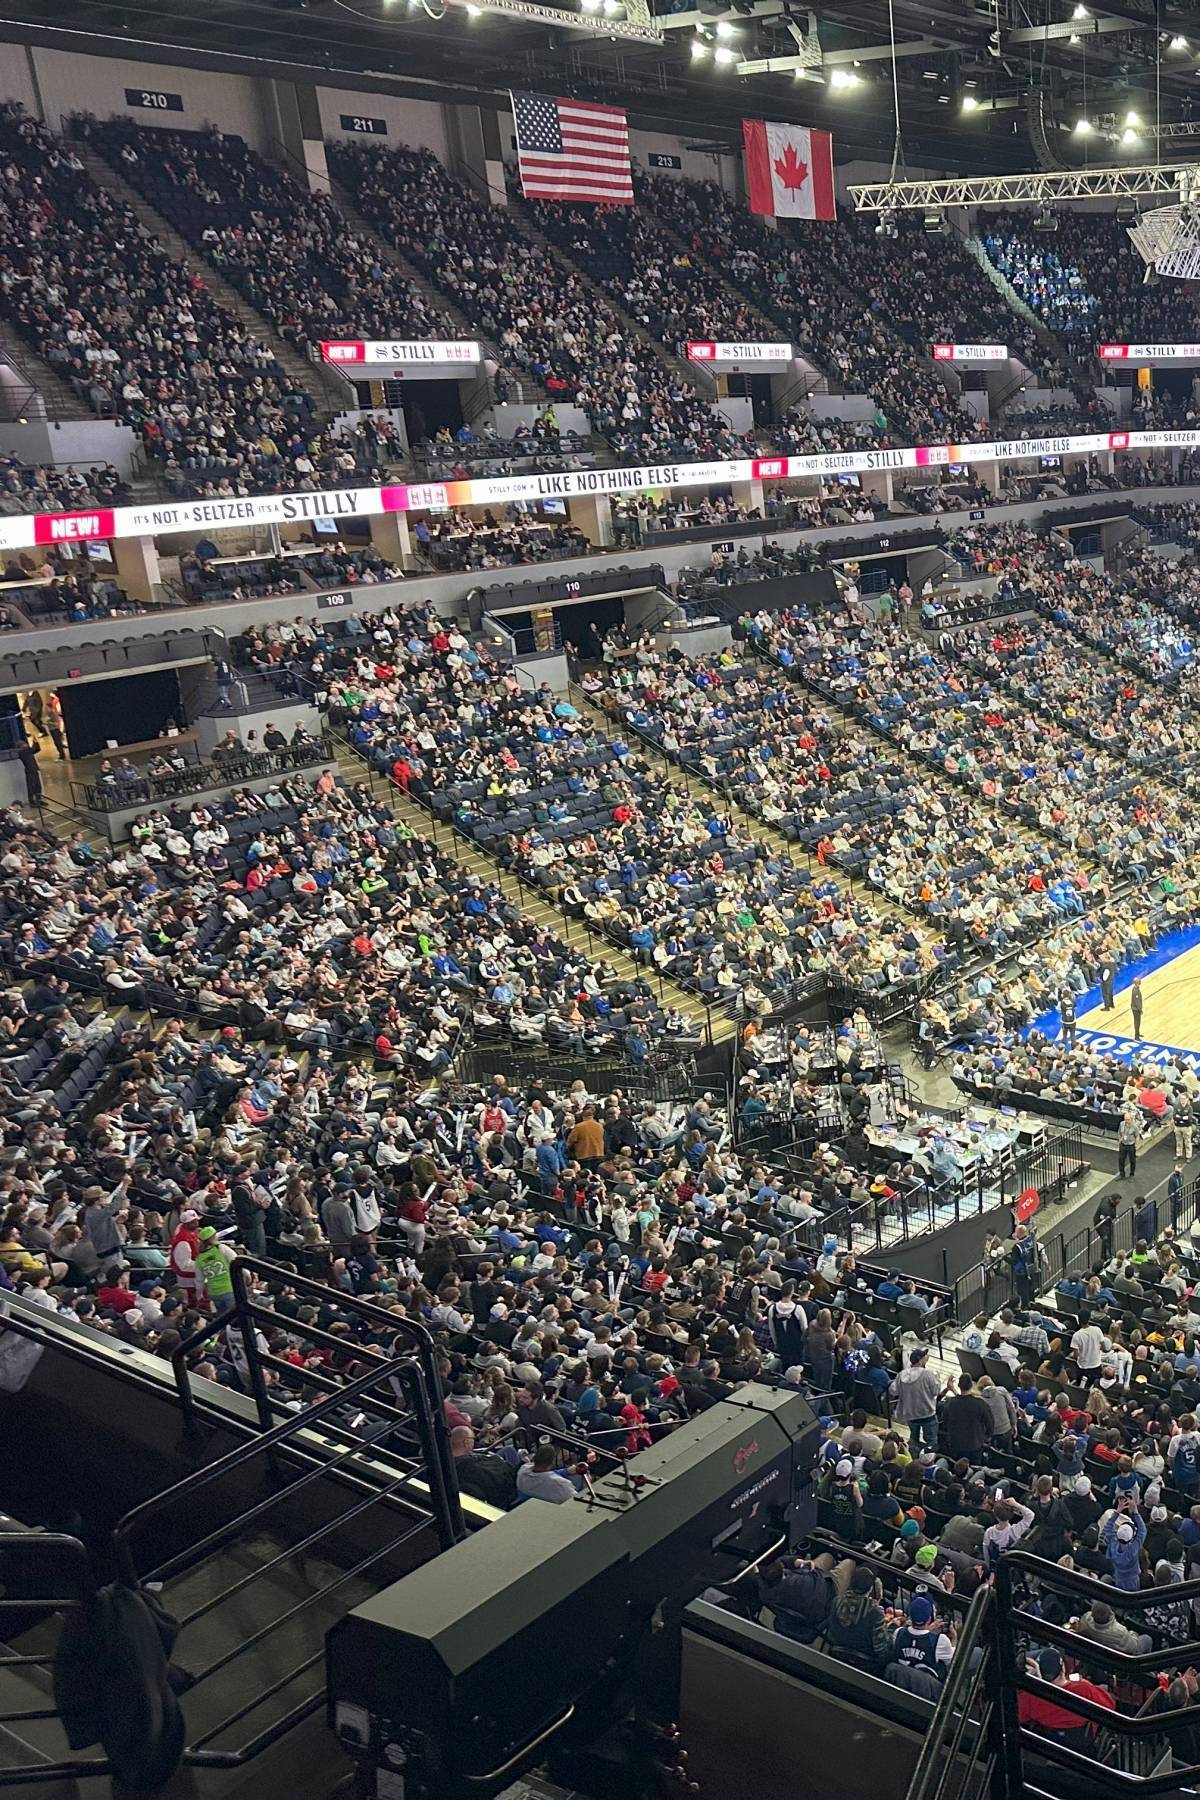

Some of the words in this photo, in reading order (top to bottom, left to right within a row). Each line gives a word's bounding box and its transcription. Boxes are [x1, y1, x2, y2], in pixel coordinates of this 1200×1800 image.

[142, 93, 168, 108] 210
[354, 118, 374, 132] 211
[658, 156, 673, 167] 213
[392, 345, 436, 359] STILLY
[734, 346, 762, 358] STILLY
[965, 347, 987, 358] STILLY
[1145, 346, 1177, 356] STILLY
[1143, 434, 1157, 443] NOT
[1163, 432, 1196, 443] SELTZER
[995, 443, 1013, 457] LIKE
[1015, 440, 1051, 455] NOTHING
[1053, 439, 1070, 451] ELSE
[805, 457, 819, 469] NOT
[824, 455, 854, 468] SELTZER
[867, 451, 905, 469] STILLY
[538, 474, 572, 495] LIKE
[576, 469, 643, 492] NOTHING
[648, 467, 680, 485] ELSE
[51, 516, 100, 539] NEW!
[134, 512, 150, 525] IT'S
[152, 509, 179, 526] NOT
[184, 512, 190, 521] A
[193, 502, 255, 523] SELTZER
[282, 492, 359, 520] STILLY
[879, 539, 890, 548] 112
[565, 581, 580, 592] 110
[325, 594, 345, 607] 109
[364, 1200, 372, 1212] 5
[1021, 1196, 1035, 1210] TCL
[204, 1261, 227, 1280] 32
[352, 1267, 361, 1281] 5
[1185, 1451, 1196, 1465] 5
